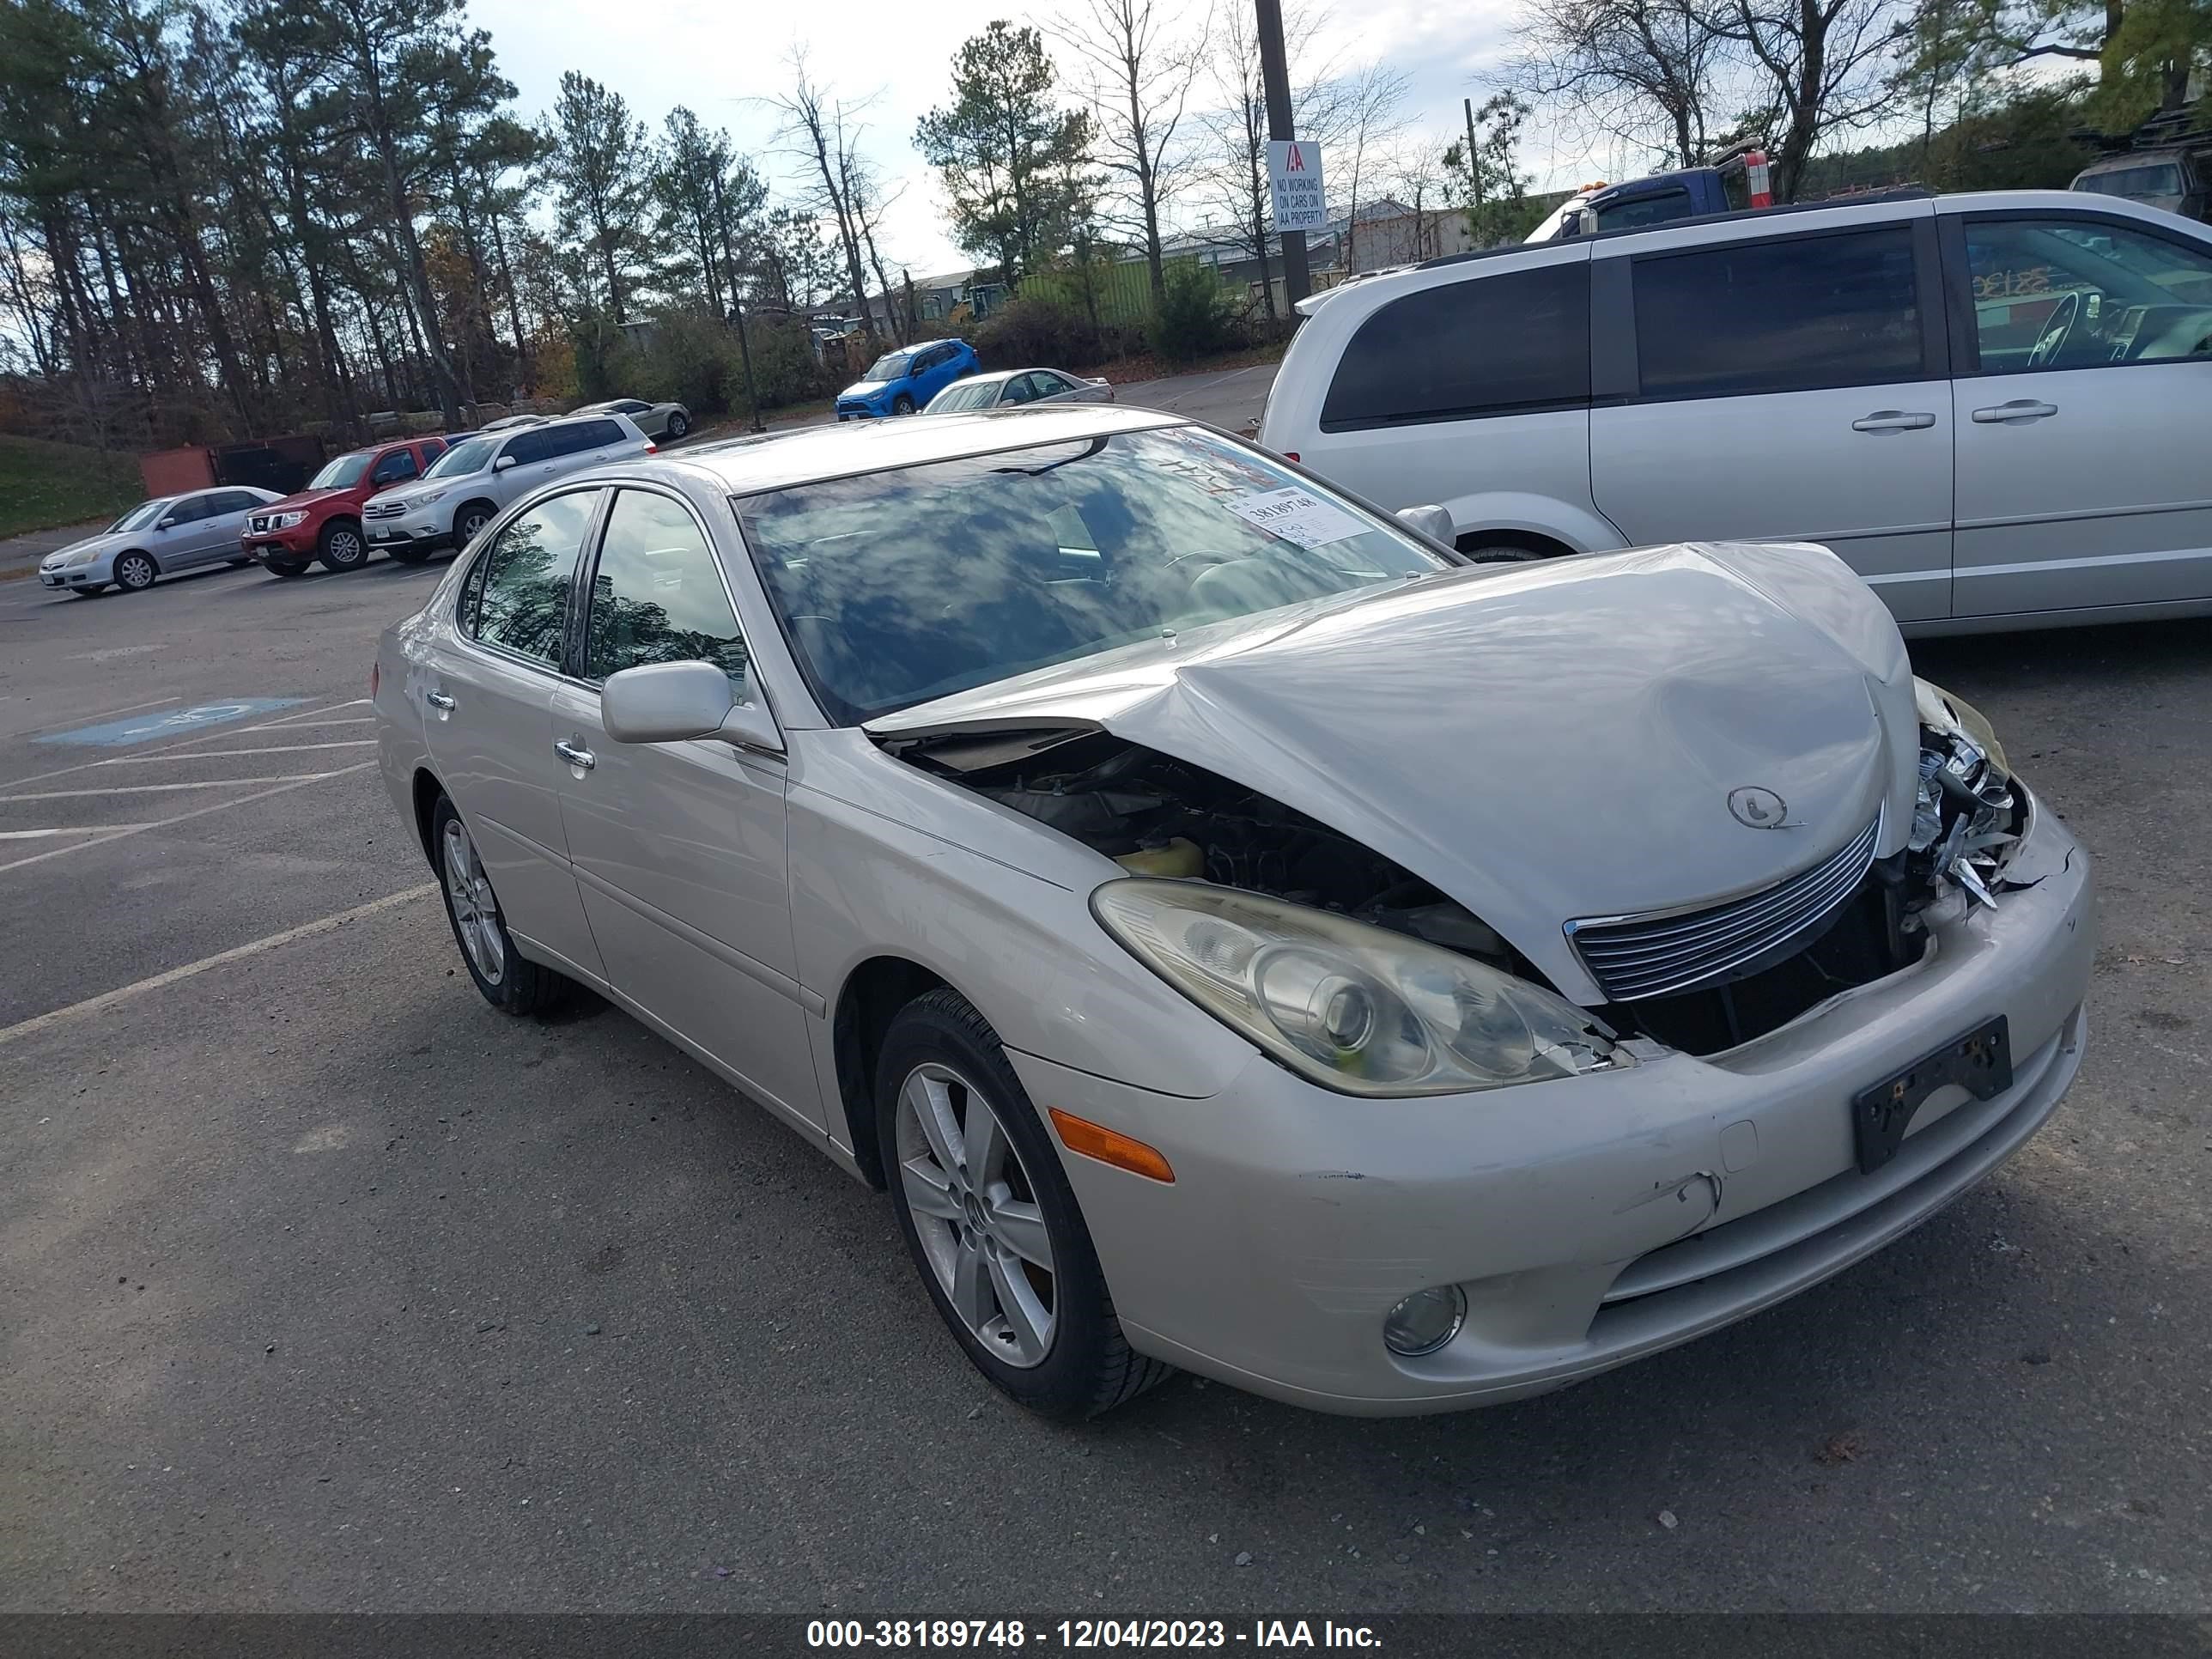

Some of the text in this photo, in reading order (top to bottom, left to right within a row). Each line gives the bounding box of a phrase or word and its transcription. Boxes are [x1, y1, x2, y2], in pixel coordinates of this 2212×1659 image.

[1278, 178, 1317, 192] NO WORKING
[1279, 194, 1319, 209] ON CARS ON
[1278, 210, 1322, 226] IAA PROPERTY
[1249, 496, 1318, 520] 38189748
